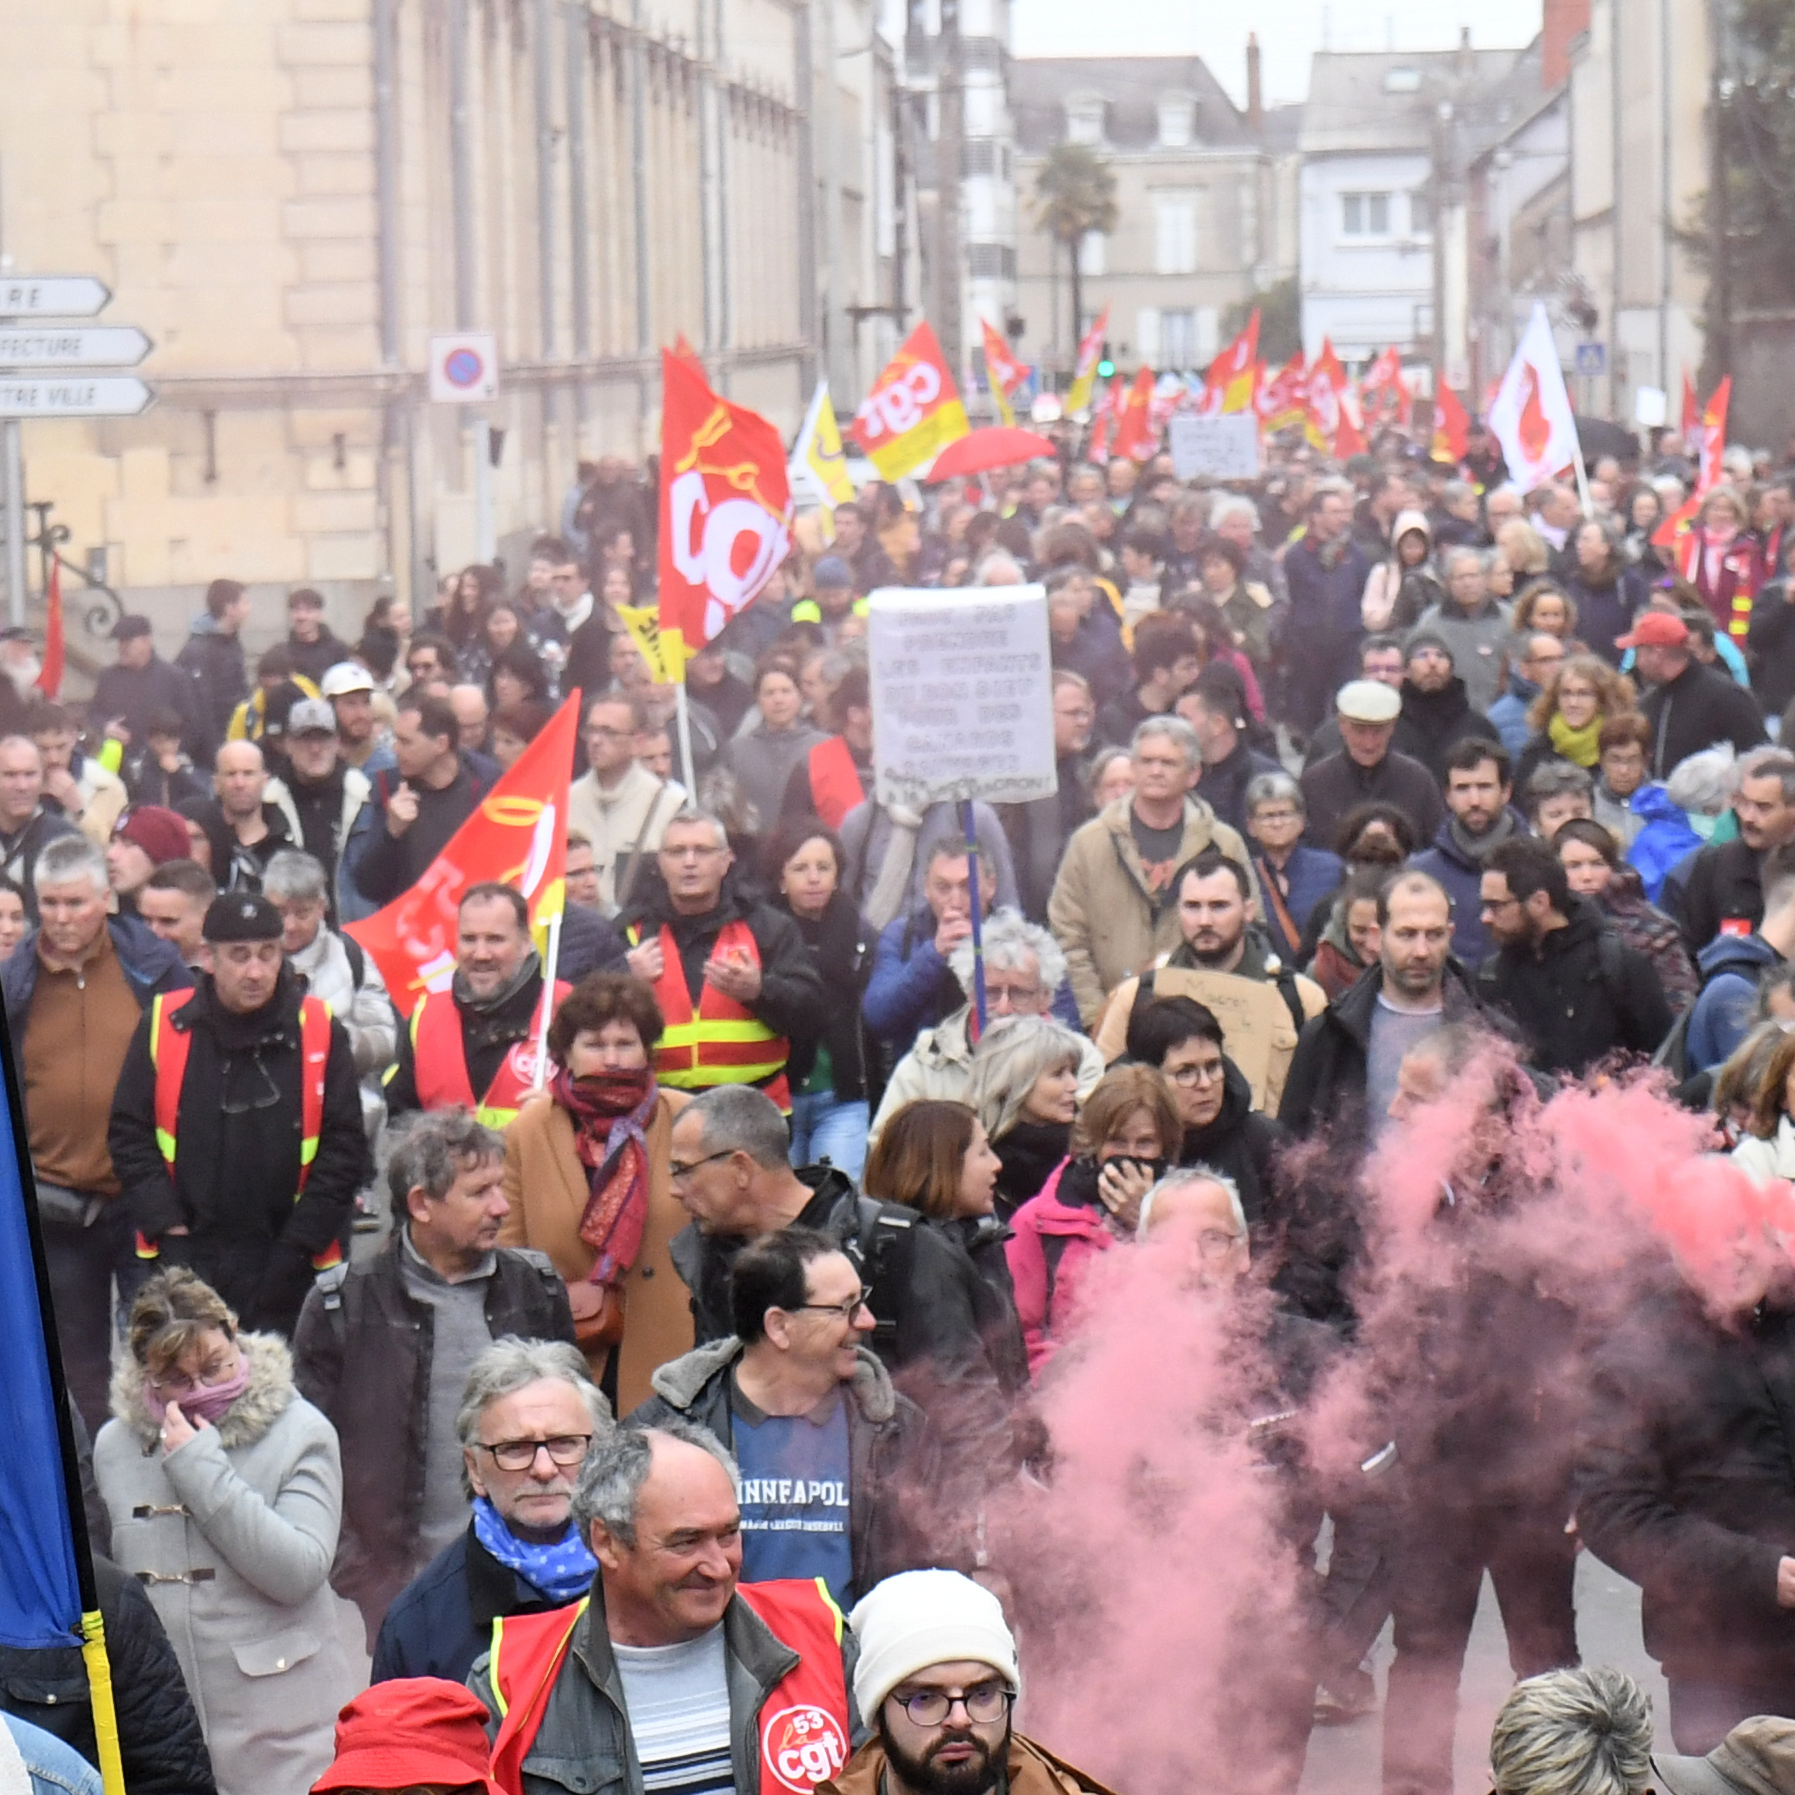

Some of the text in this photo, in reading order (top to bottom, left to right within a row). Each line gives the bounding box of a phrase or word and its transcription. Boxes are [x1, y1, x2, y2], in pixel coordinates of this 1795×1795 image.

[47, 386, 96, 407] VILLE
[792, 1711, 824, 1735] 53
[778, 1730, 843, 1783] cgt
